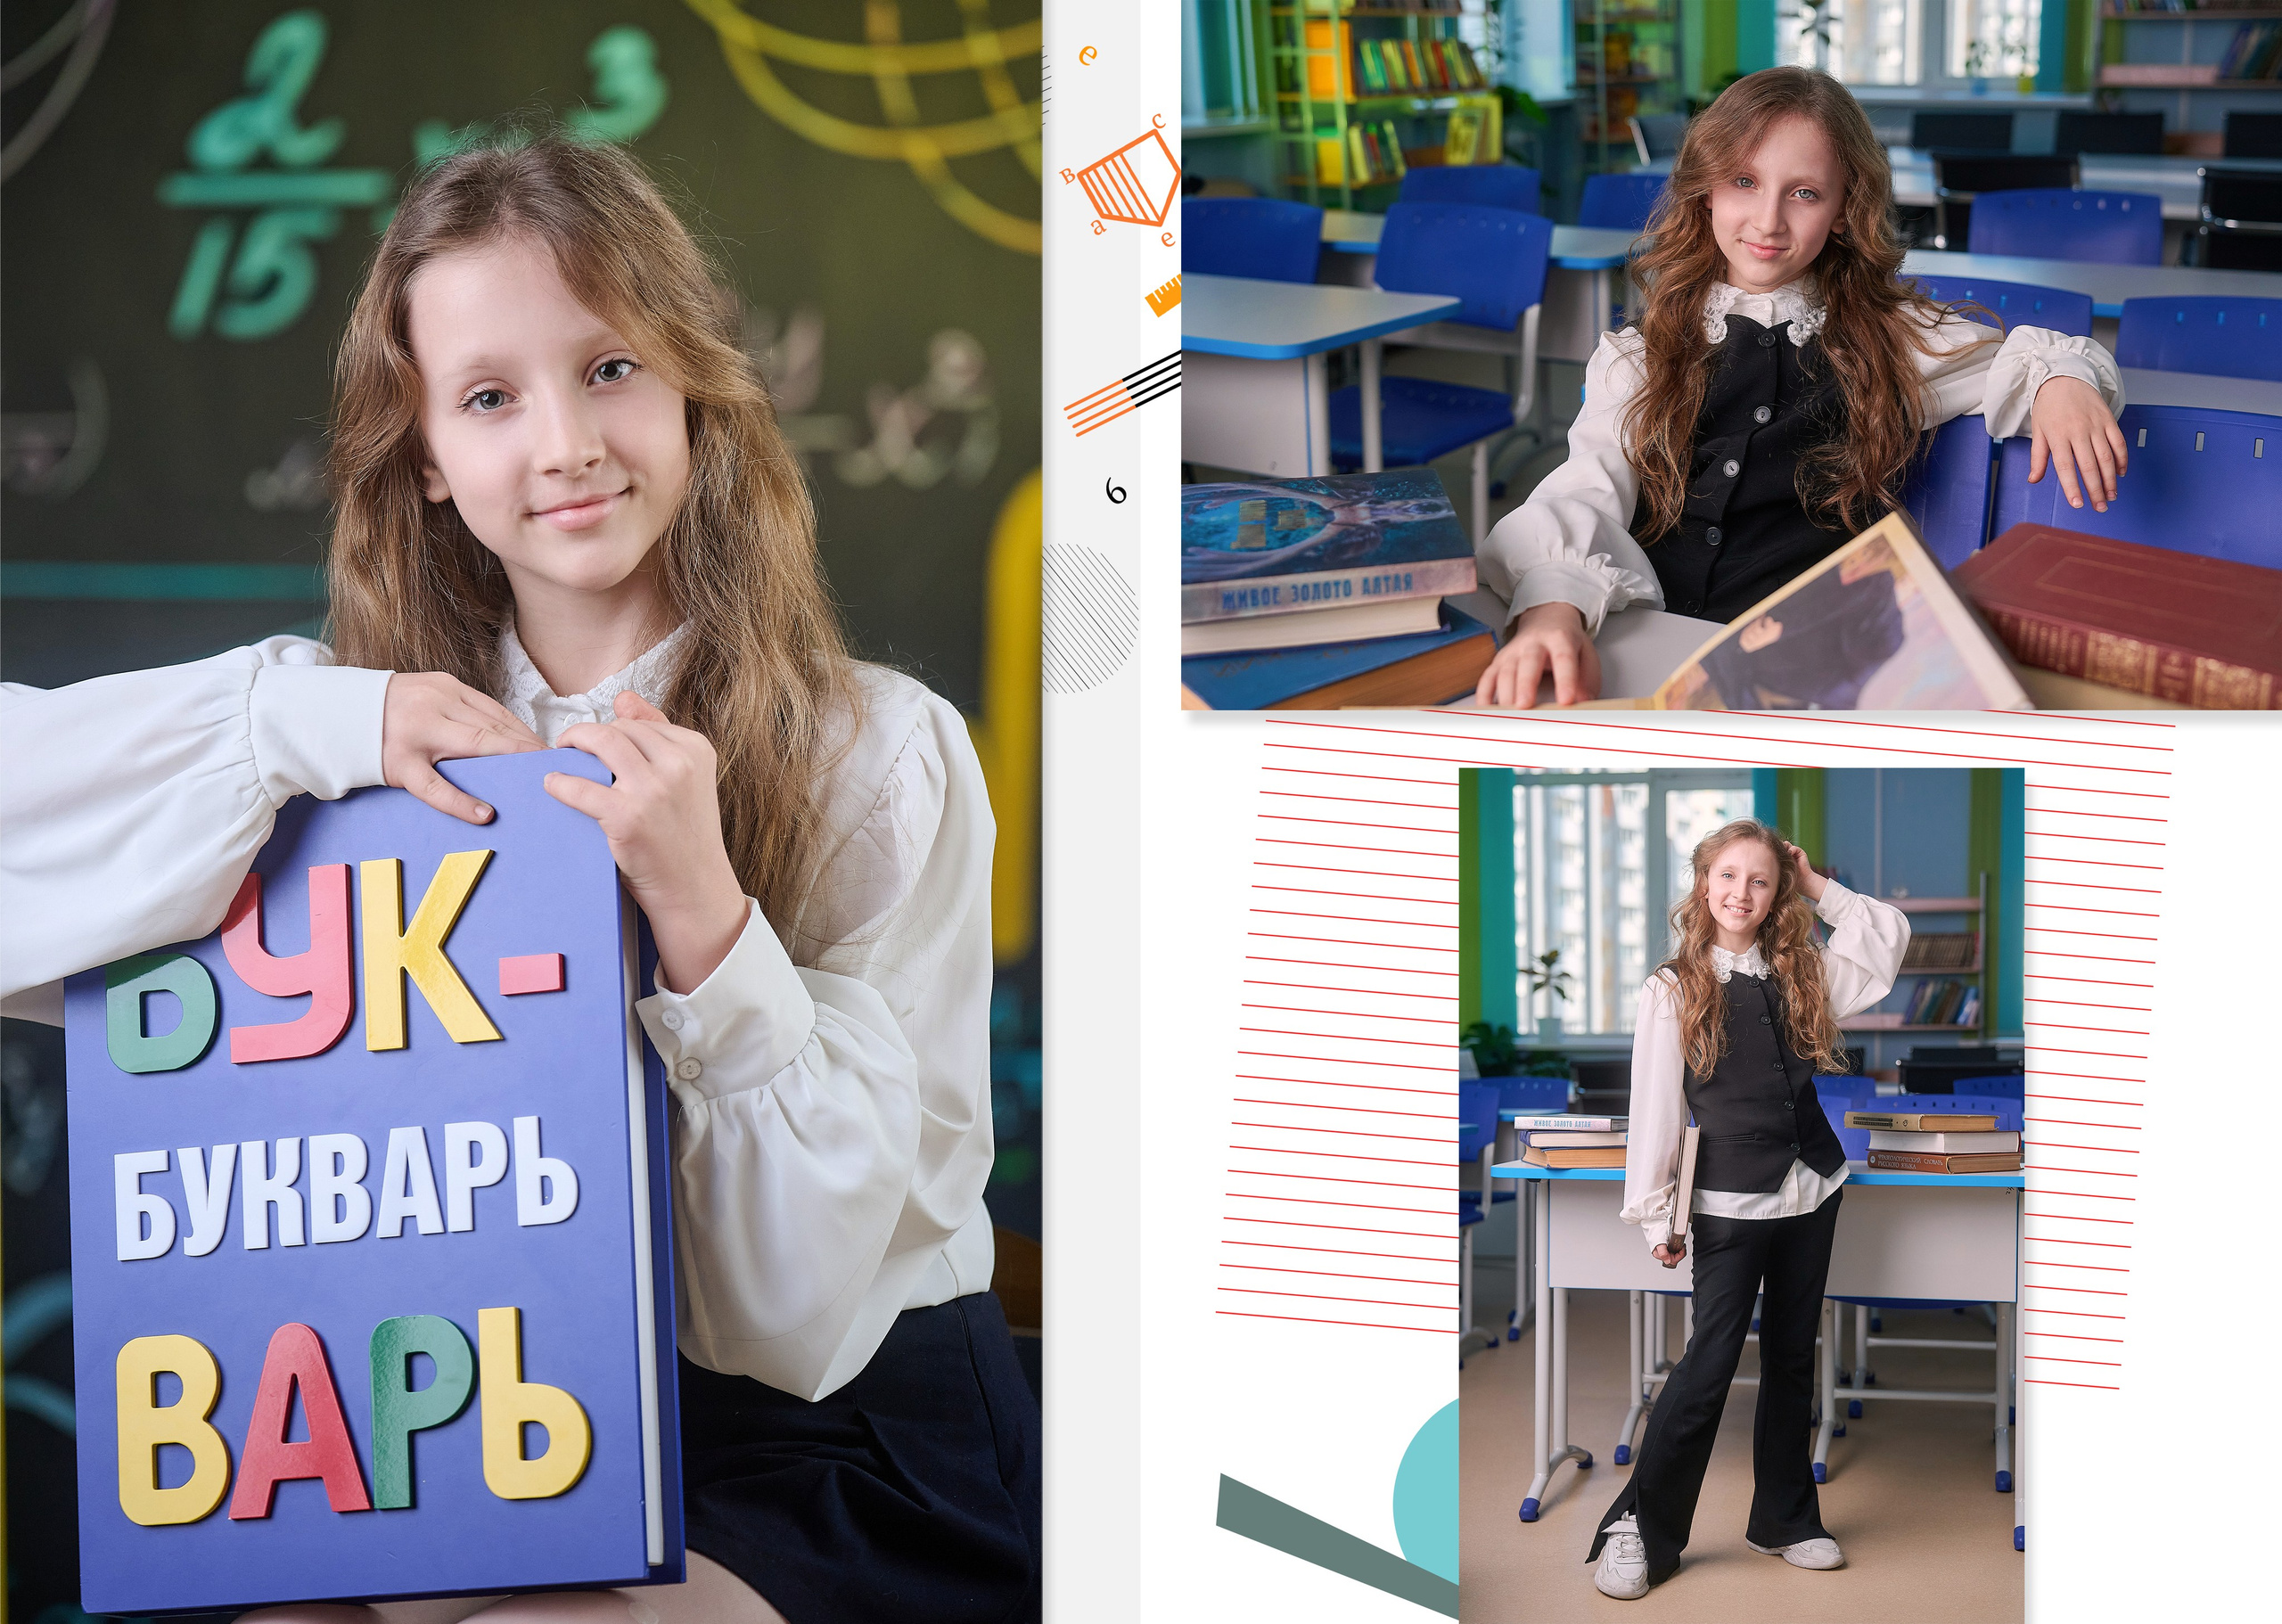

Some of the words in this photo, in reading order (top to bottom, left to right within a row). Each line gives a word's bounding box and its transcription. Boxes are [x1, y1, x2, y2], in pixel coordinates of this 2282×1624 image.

[169, 208, 342, 339] 15
[1222, 586, 1280, 610] ЖИВОЕ
[1291, 579, 1351, 603] ЗОЛОТО
[1362, 572, 1413, 595] АЛТАЯ
[113, 1116, 581, 1261] БУКВАРЬ
[116, 1307, 593, 1528] ВАРЬ
